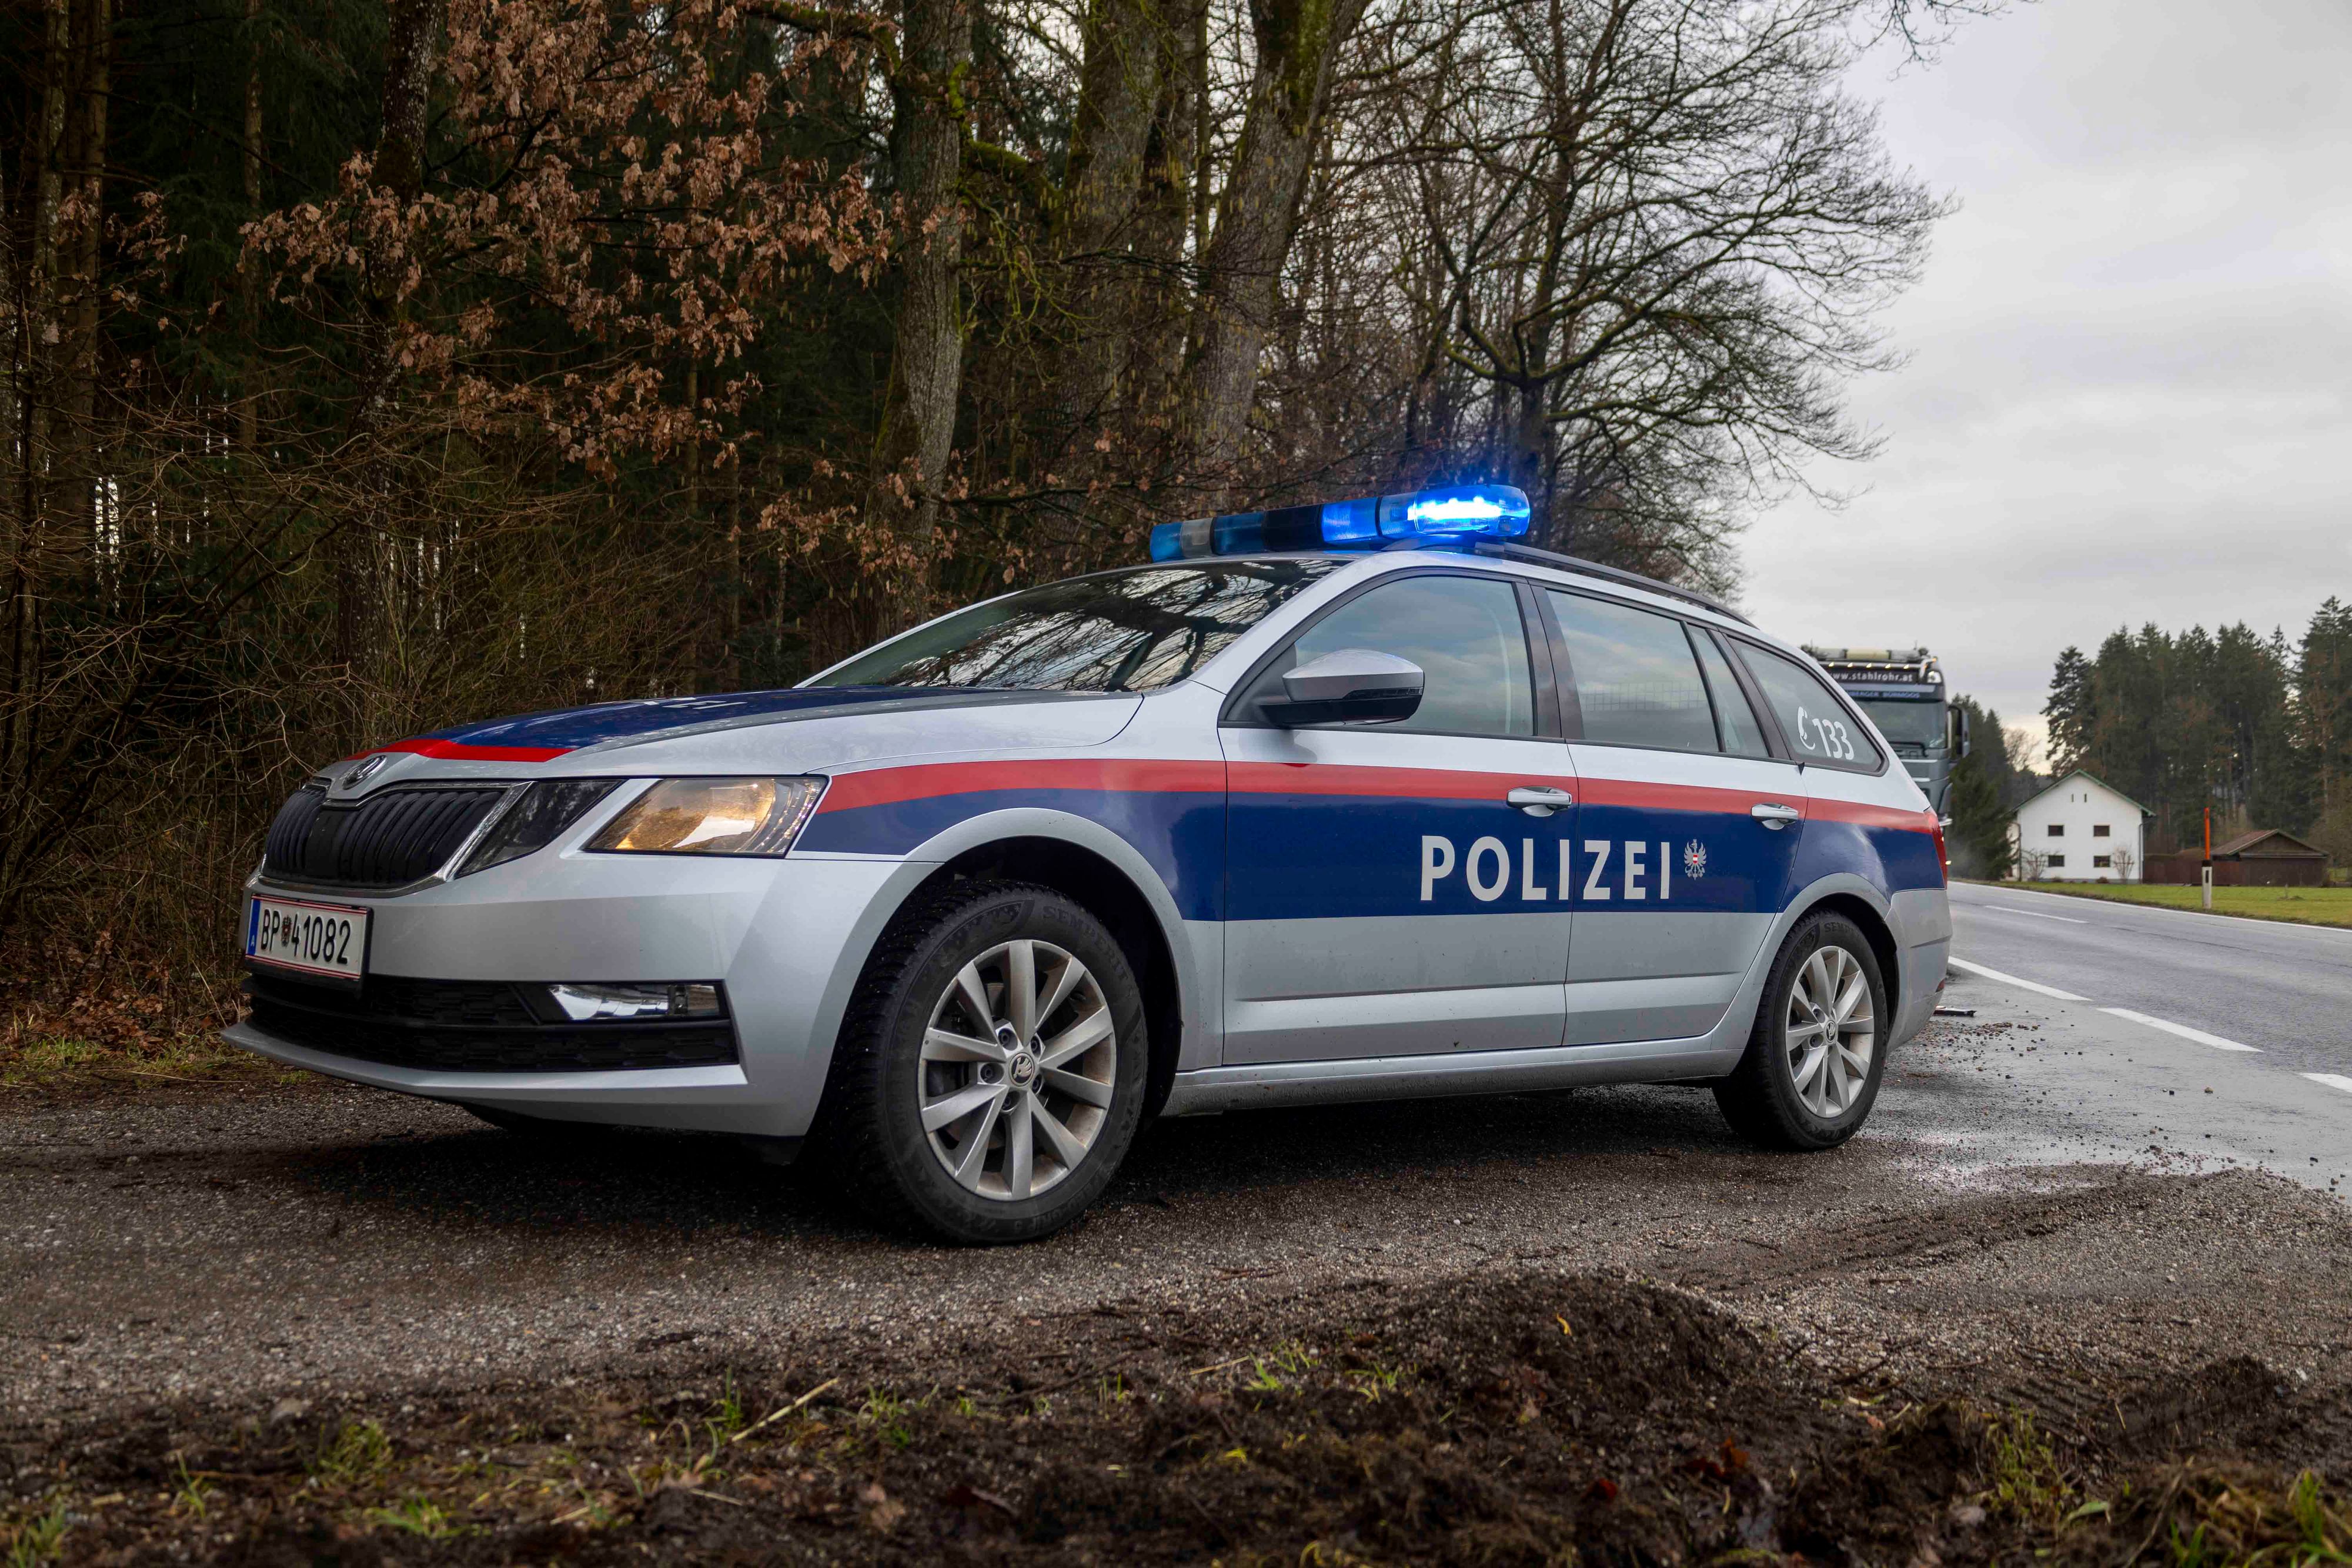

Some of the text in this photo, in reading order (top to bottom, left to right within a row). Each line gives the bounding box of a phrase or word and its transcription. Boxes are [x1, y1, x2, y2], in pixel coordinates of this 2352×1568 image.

[1830, 672, 1913, 682] ww.stahlrohr.at
[1812, 718, 1855, 760] 133
[1420, 835, 1670, 901] POLIZEI
[260, 909, 351, 965] BP 41082
